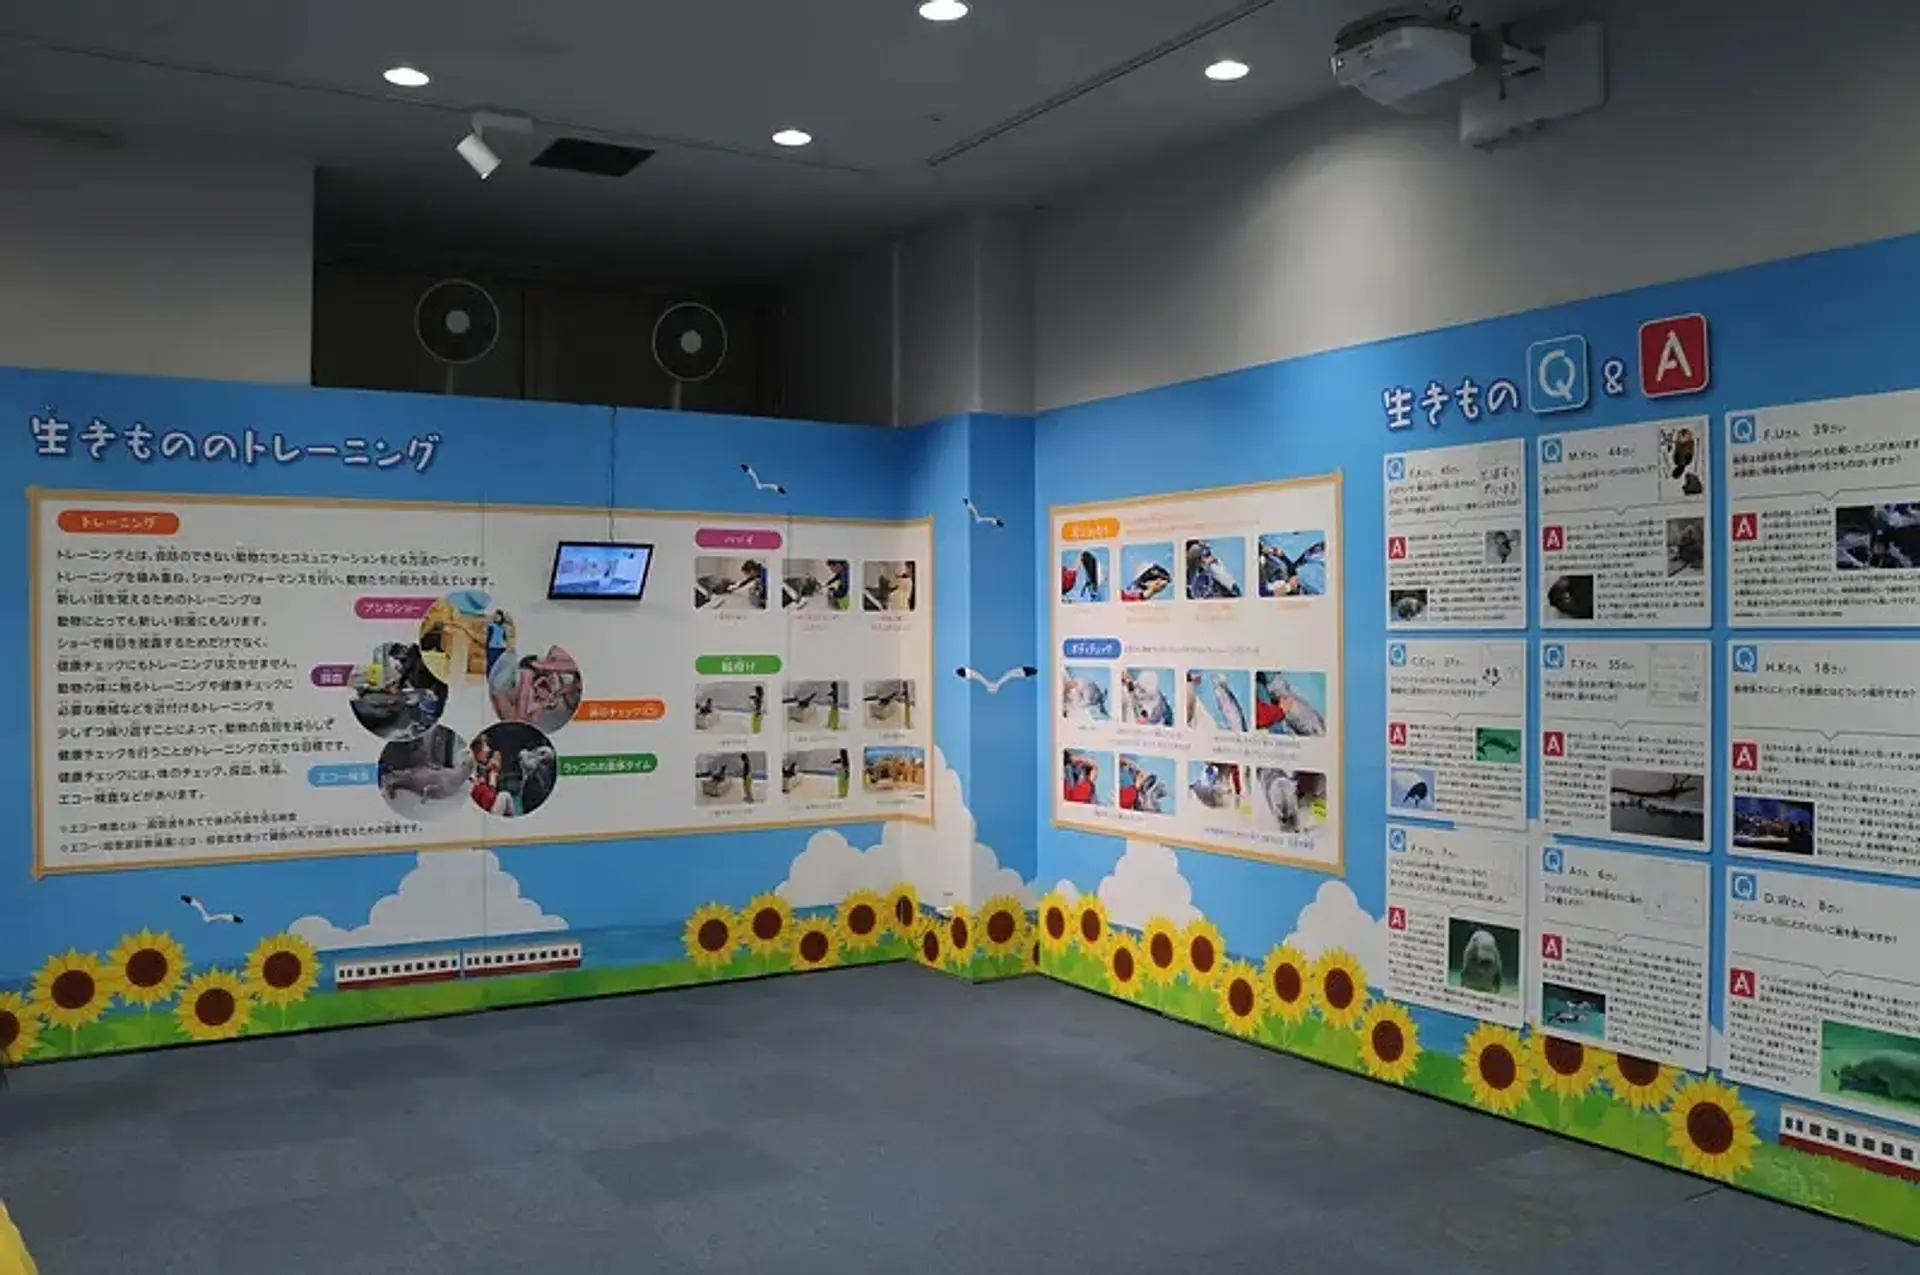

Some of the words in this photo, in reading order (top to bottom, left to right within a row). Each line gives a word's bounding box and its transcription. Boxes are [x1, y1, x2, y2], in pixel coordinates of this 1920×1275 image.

[1383, 378, 1519, 429] 生きもの
[1538, 349, 1575, 399] Q
[1602, 358, 1625, 395] &
[1655, 329, 1692, 382] A
[29, 414, 442, 473] 生きもののトレーニング
[80, 514, 158, 531] トレーニング
[1736, 517, 1752, 537] A
[1391, 539, 1404, 557] A
[1545, 529, 1560, 549] A
[1391, 725, 1404, 745] A
[1546, 734, 1561, 754] A
[1736, 745, 1753, 767] A
[1544, 936, 1560, 958] A
[1734, 972, 1751, 995] A
